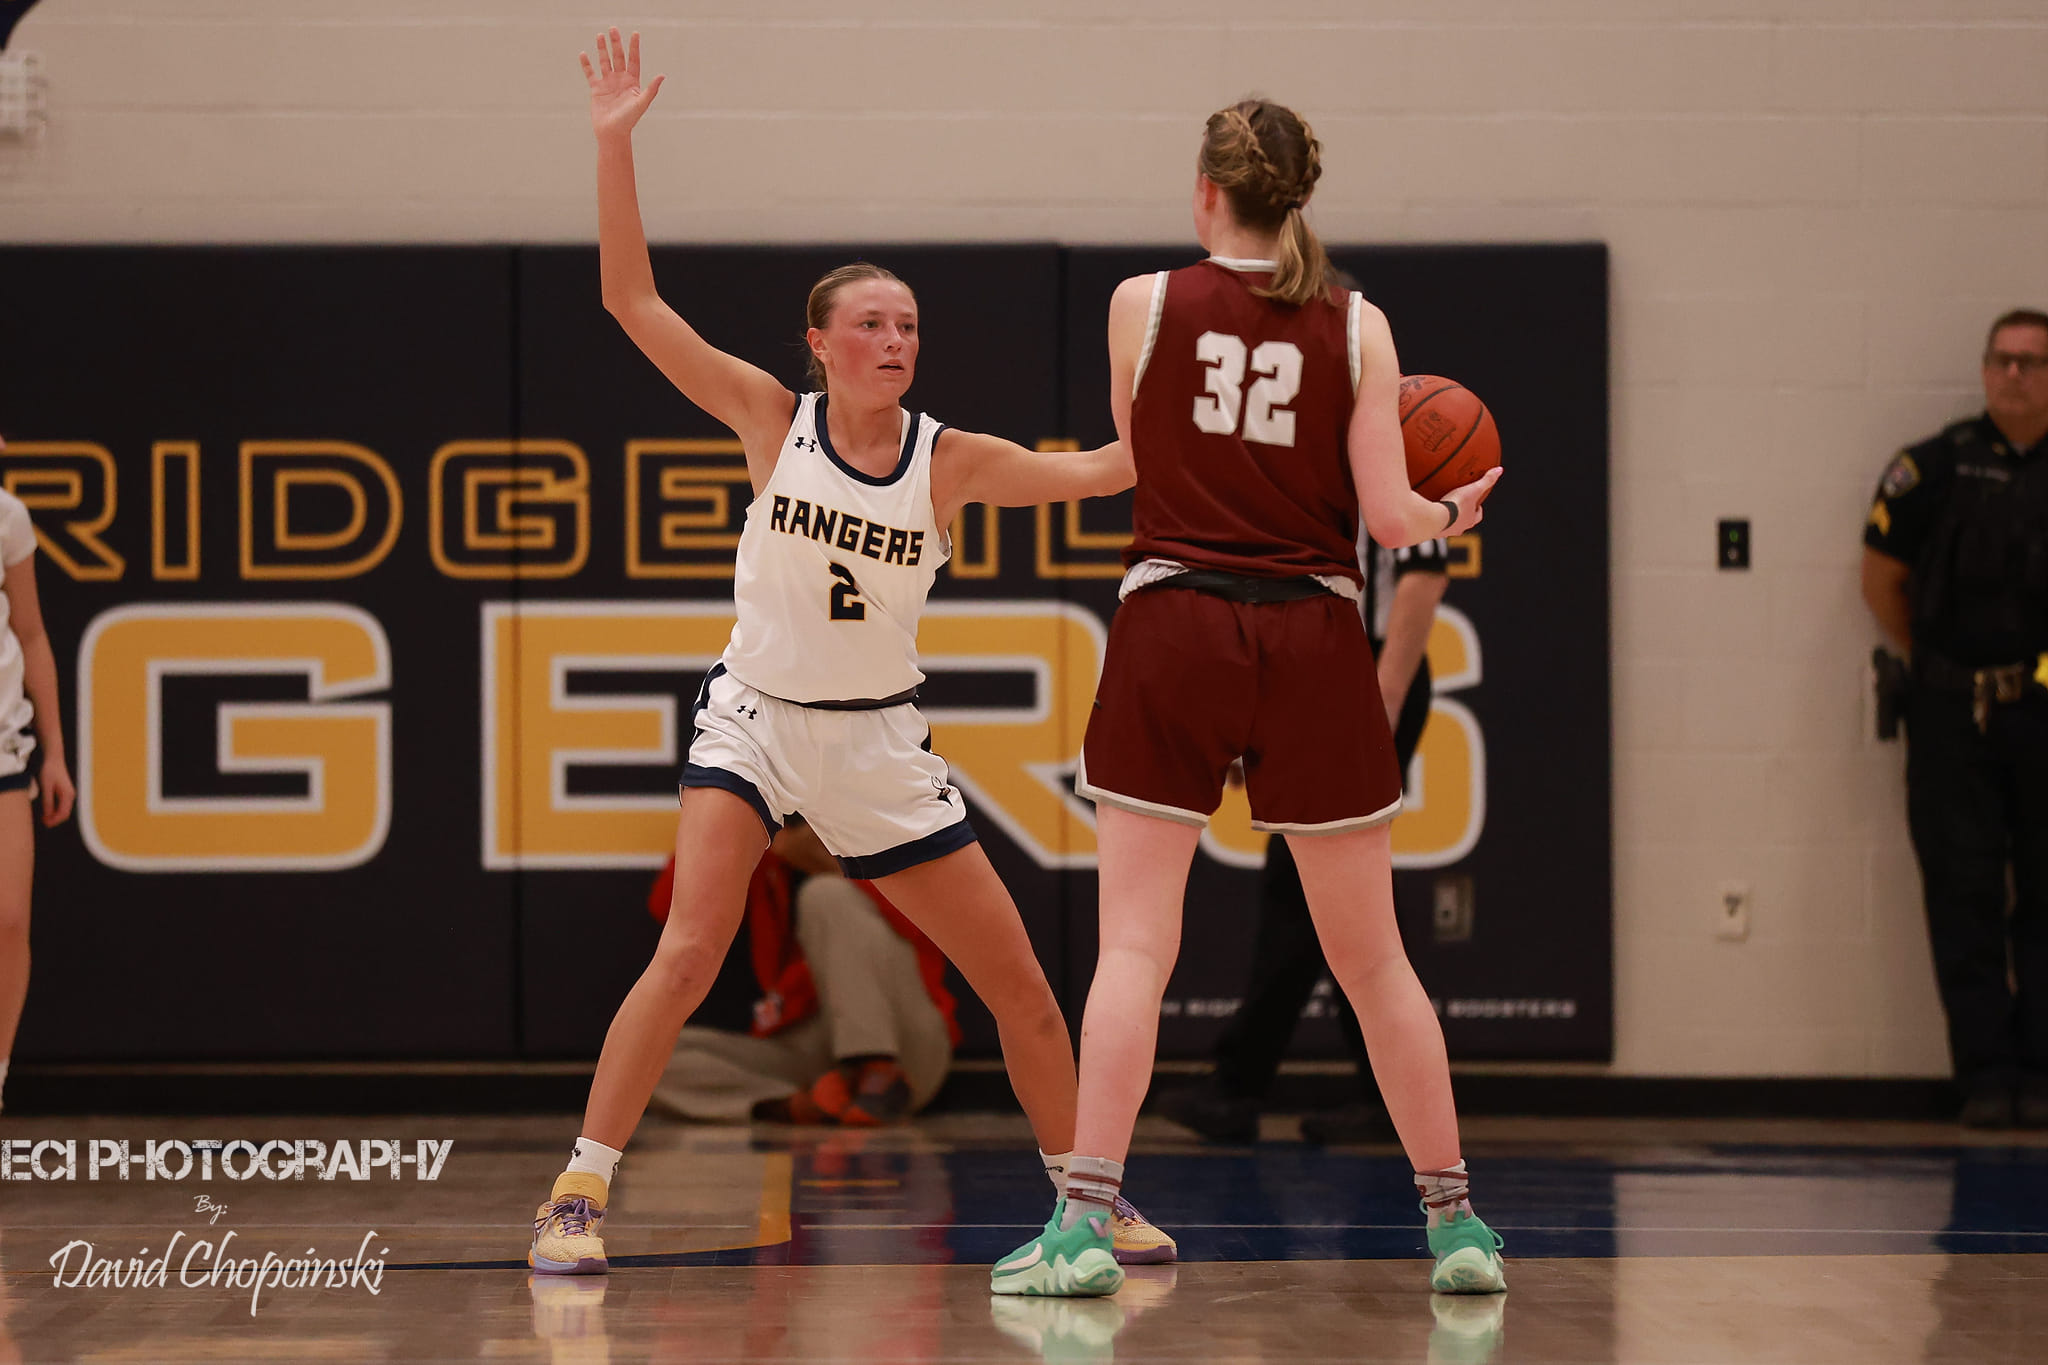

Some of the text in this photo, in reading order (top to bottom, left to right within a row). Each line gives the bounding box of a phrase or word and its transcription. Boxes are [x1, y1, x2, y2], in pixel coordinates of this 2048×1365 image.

[1192, 330, 1304, 448] 32
[0, 440, 1483, 580] RIDGEIL
[770, 494, 925, 567] RANGERS
[828, 560, 866, 622] 2
